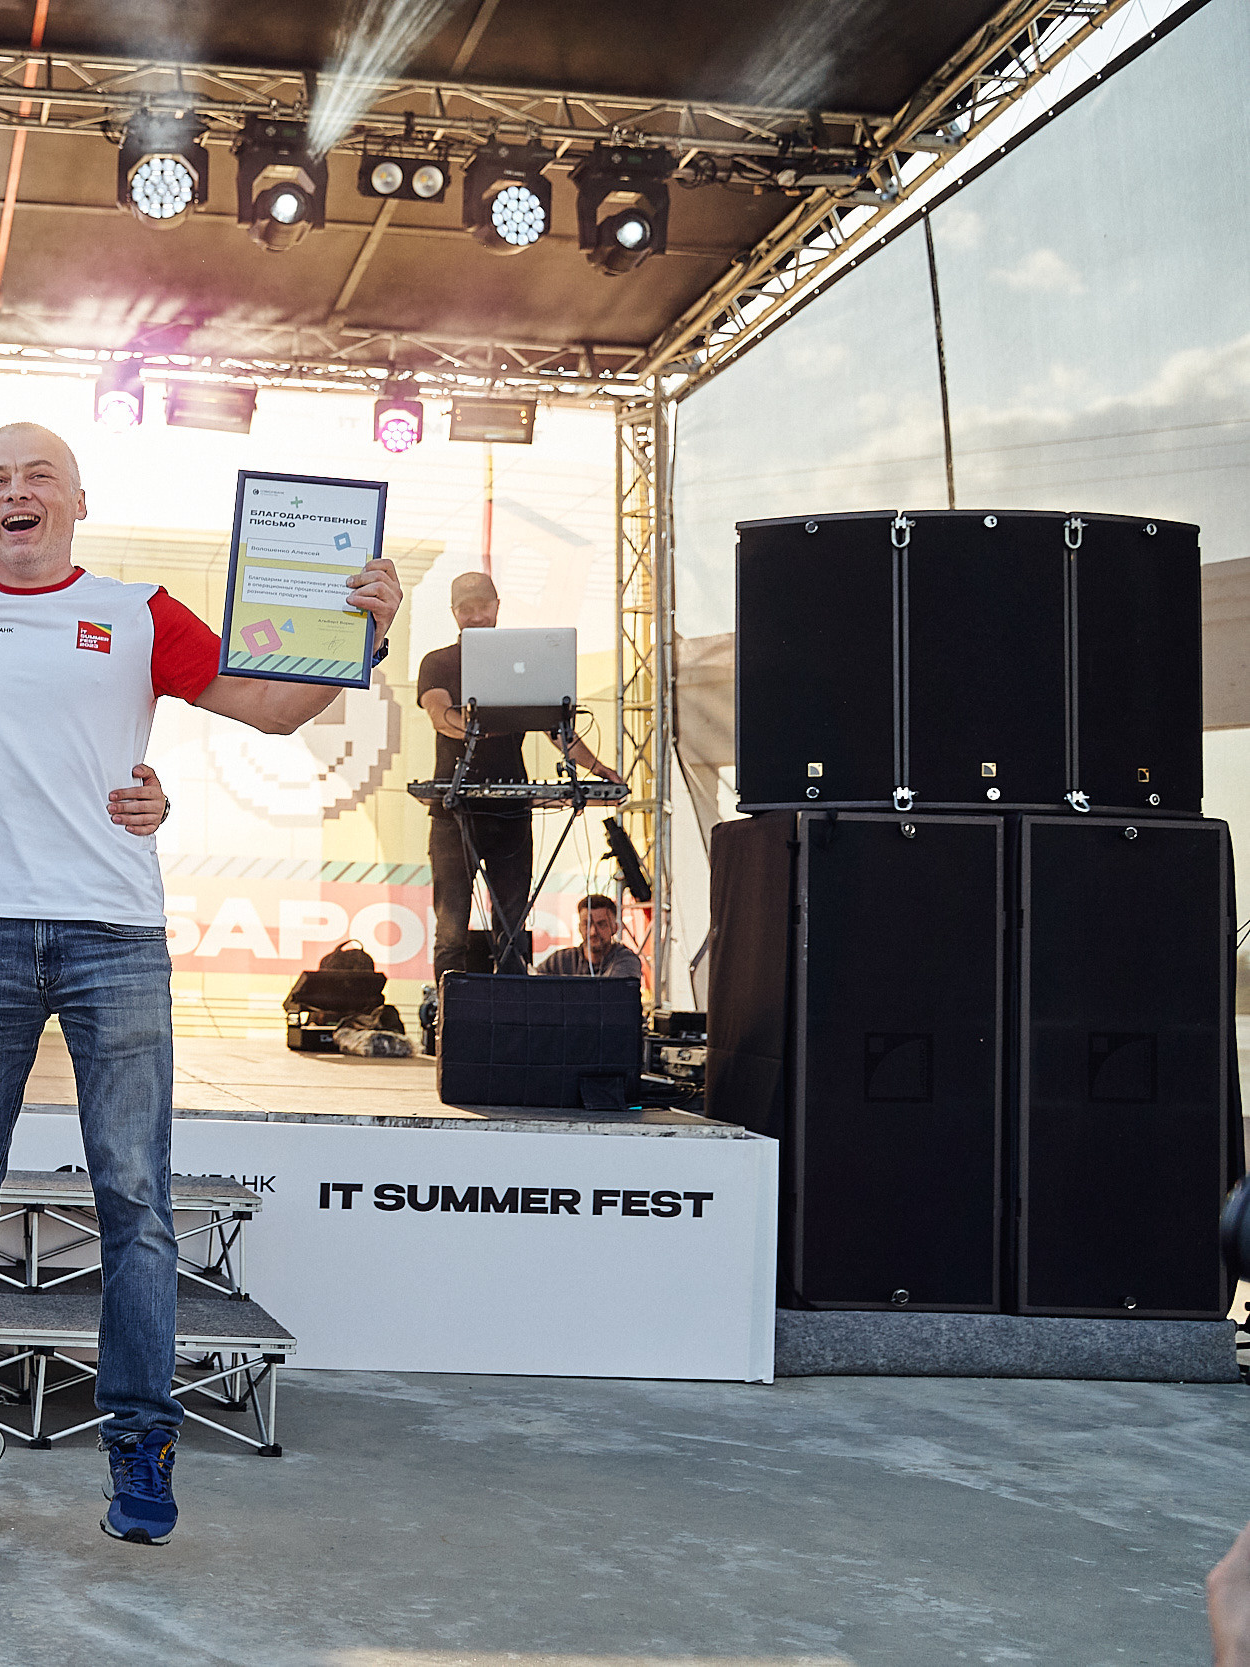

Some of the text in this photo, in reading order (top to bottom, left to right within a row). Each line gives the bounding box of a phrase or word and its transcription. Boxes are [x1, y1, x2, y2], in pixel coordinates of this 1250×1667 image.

[250, 509, 368, 526] БЛАГОДАРСТВЕННОЕ
[249, 518, 296, 528] ПИСЬМО
[290, 549, 320, 557] Алексей
[248, 574, 282, 583] Благодарим
[278, 591, 308, 599] продуктов
[80, 633, 110, 642] SUMMER
[319, 1182, 714, 1218] IT SUMMER FEST
